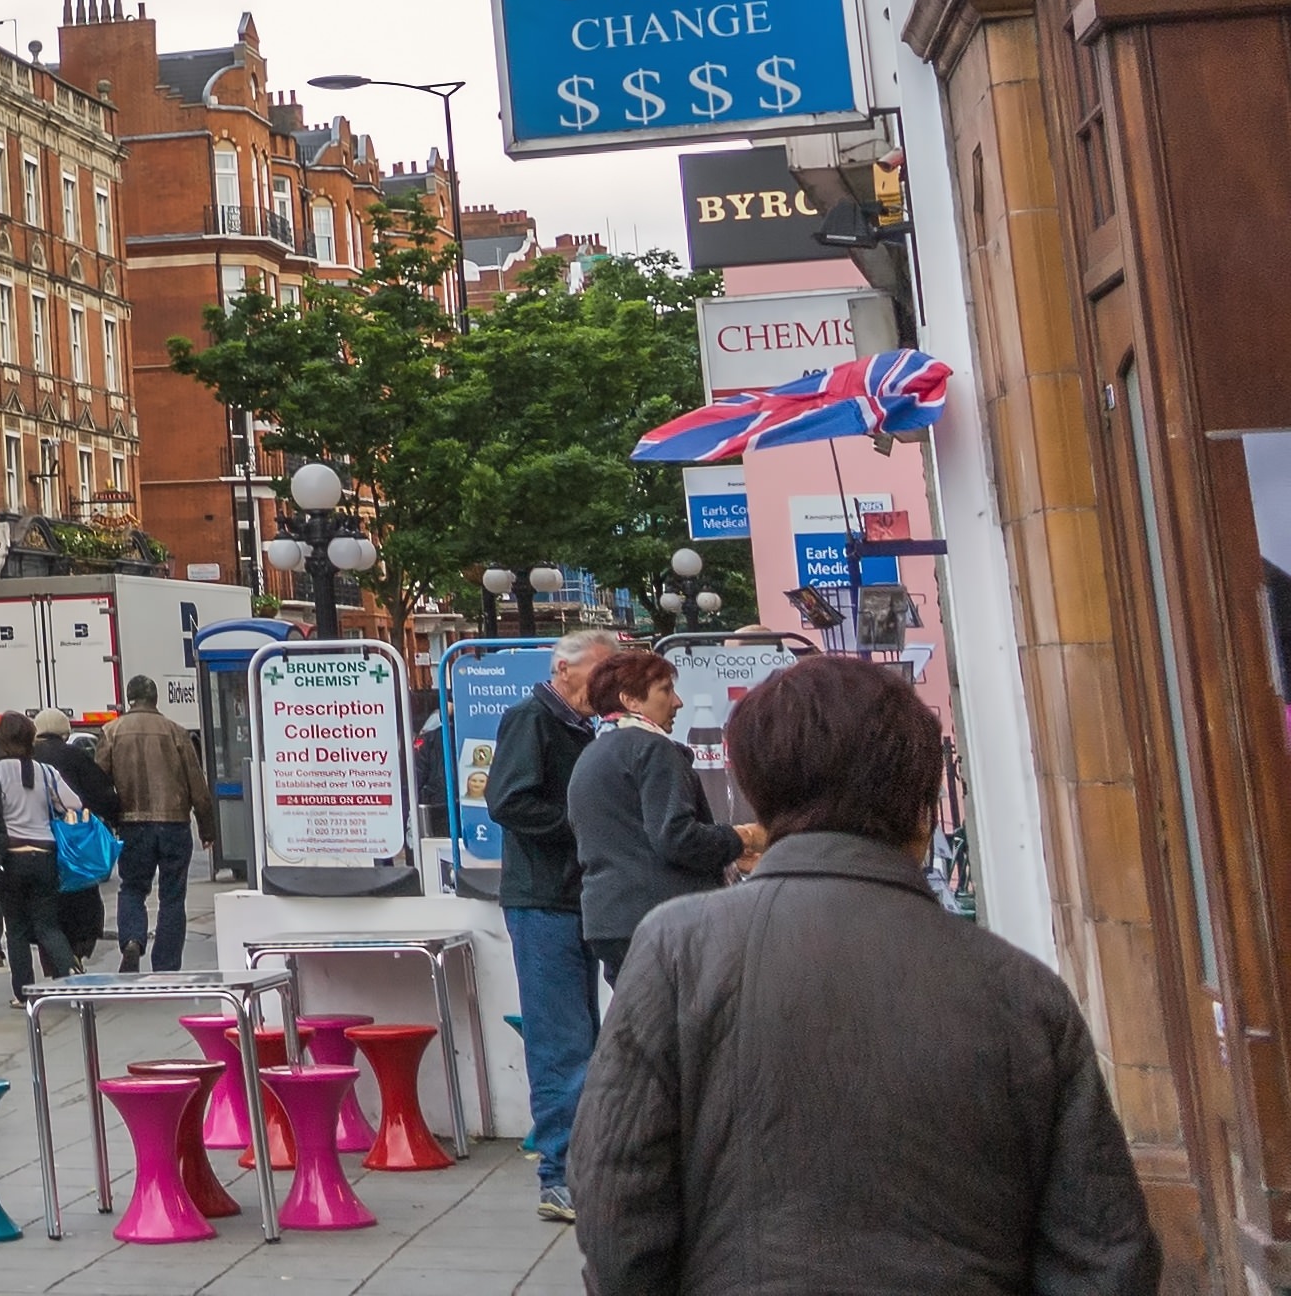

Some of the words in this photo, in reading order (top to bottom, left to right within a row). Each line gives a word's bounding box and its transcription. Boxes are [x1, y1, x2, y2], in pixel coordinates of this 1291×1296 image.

[571, 0, 773, 52] CHANGE
[702, 505, 728, 516] Earls
[703, 517, 748, 529] Medical
[806, 546, 838, 560] Earls
[807, 561, 863, 575] Medicl
[286, 661, 367, 674] BRUNTONS
[674, 654, 711, 669] Enjoy
[714, 654, 756, 665] Coca
[760, 653, 795, 665] Cola
[467, 666, 506, 676] Polaroid
[294, 675, 361, 687] CHEMIST
[168, 680, 196, 704] Bidvest
[468, 682, 517, 697] Instant
[274, 700, 385, 719] Prescription
[284, 724, 377, 739] Collection
[275, 747, 309, 763] and
[315, 747, 388, 765] Delivery
[696, 749, 721, 761] Coke
[274, 769, 295, 777] Your
[296, 769, 346, 779] Community
[349, 769, 392, 778] Pharmacy
[275, 780, 327, 788] Established
[351, 780, 366, 788] 100
[368, 781, 392, 789] years
[287, 796, 298, 804] 24
[301, 796, 337, 804] HOURS
[339, 796, 354, 804] ON
[357, 796, 381, 804] CALL
[315, 828, 329, 836] 020
[331, 828, 348, 836] 7373
[476, 824, 488, 841] £
